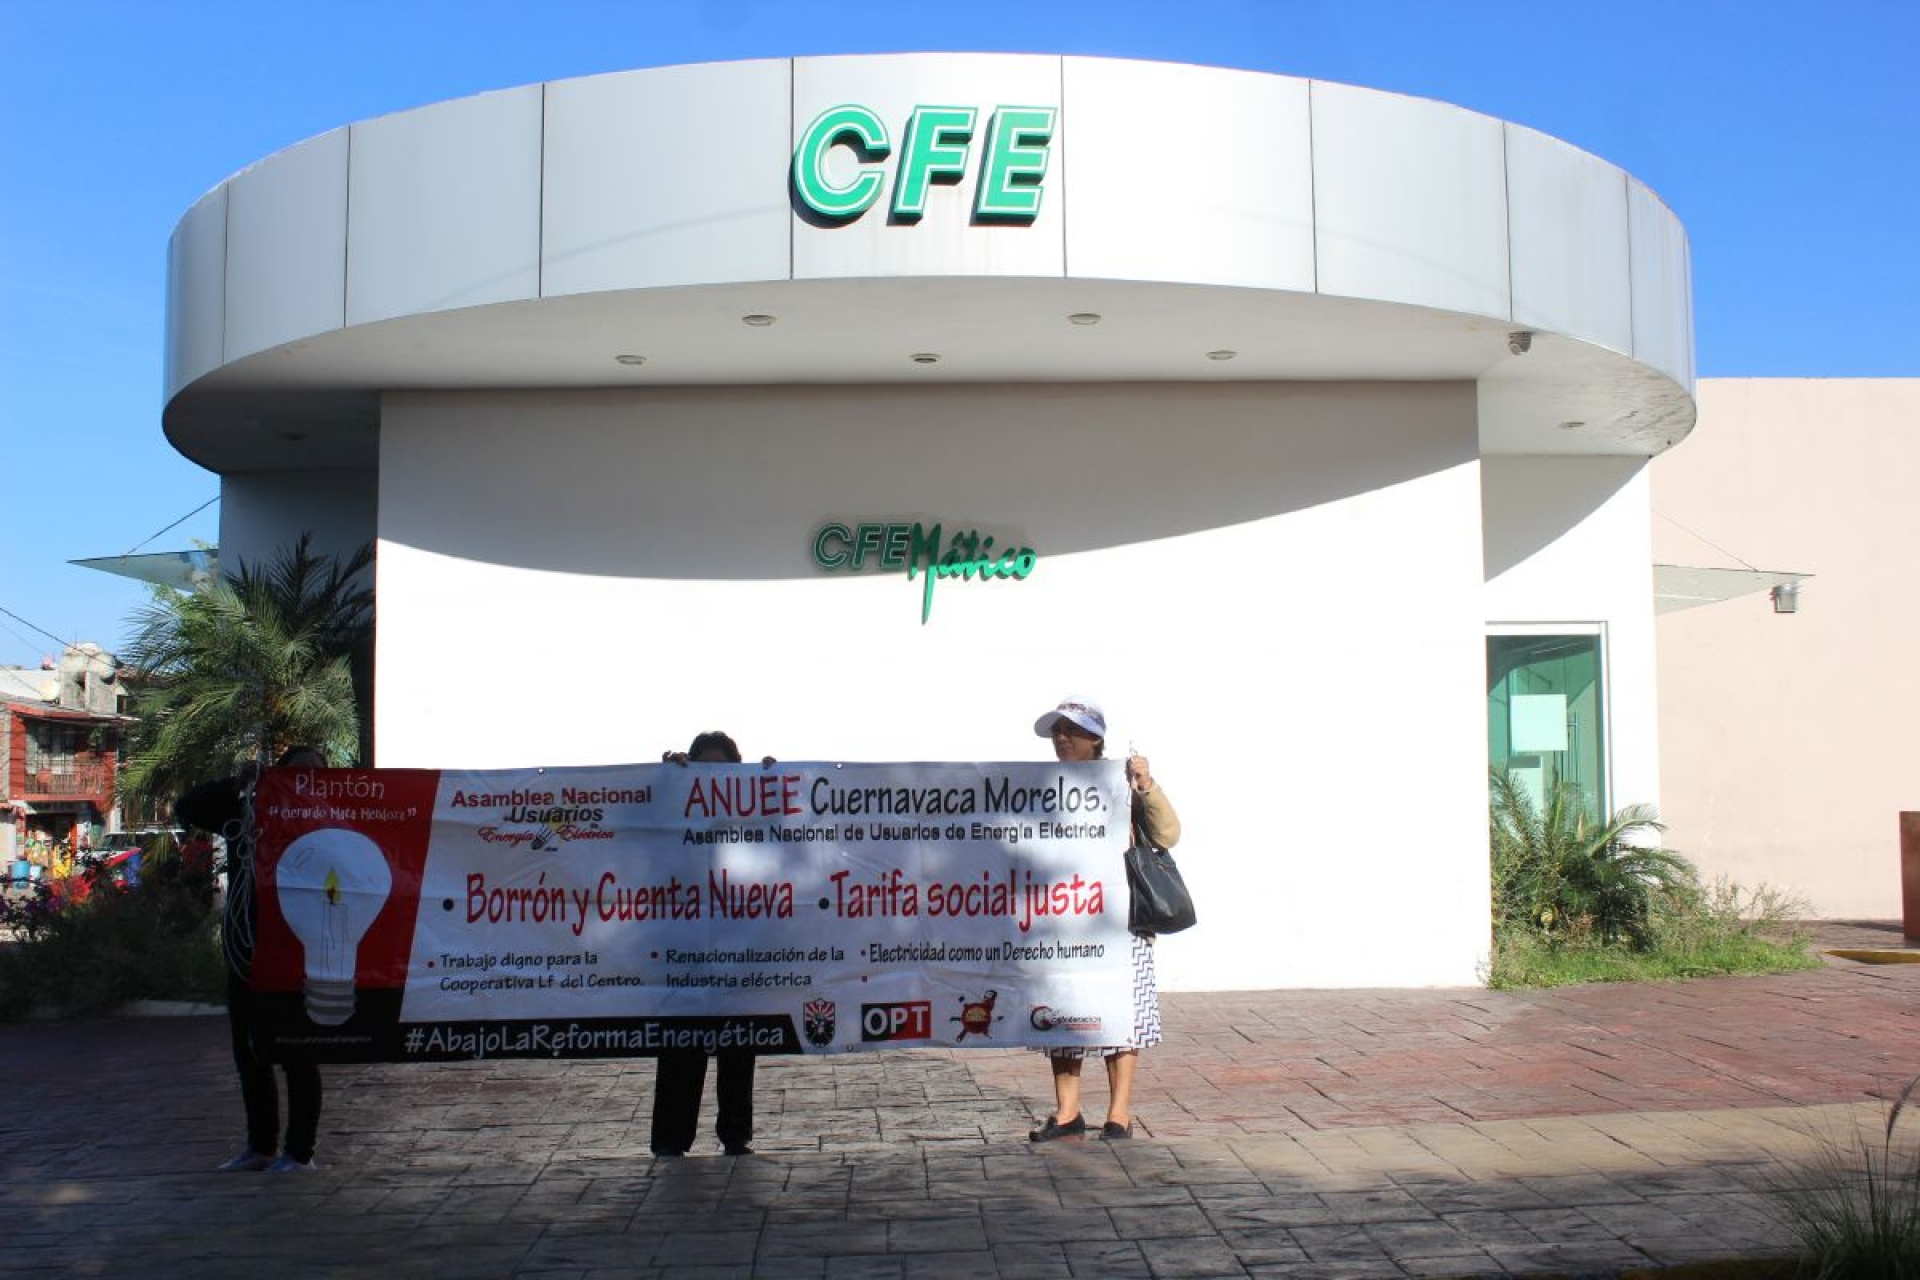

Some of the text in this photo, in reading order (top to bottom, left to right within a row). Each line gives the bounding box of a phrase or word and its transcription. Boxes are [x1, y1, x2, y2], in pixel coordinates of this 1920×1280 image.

[791, 104, 1057, 228] CFE
[295, 770, 384, 798] Plantón
[451, 784, 652, 807] Asamblea Nacional
[684, 775, 1107, 818] ANUEE Cuernavaca Morelos.
[511, 805, 604, 824] Usuarios
[683, 821, 1106, 845] Asamblea Nacional de Usuarios de Energía Eléctrica
[466, 868, 1104, 937] Borrón y Cuenta Nueva Tarifa social justa
[440, 951, 598, 971] Trabajo digno para la
[666, 947, 845, 964] Renacionalización de la
[869, 940, 1105, 963] Electricidad como un Derecho humano
[440, 975, 535, 995] Cooperativa
[560, 974, 584, 988] del
[666, 972, 812, 988] Industria eléctrica
[863, 1006, 929, 1036] OPT
[404, 1021, 784, 1059] #AbajoLaReformaEnergética
